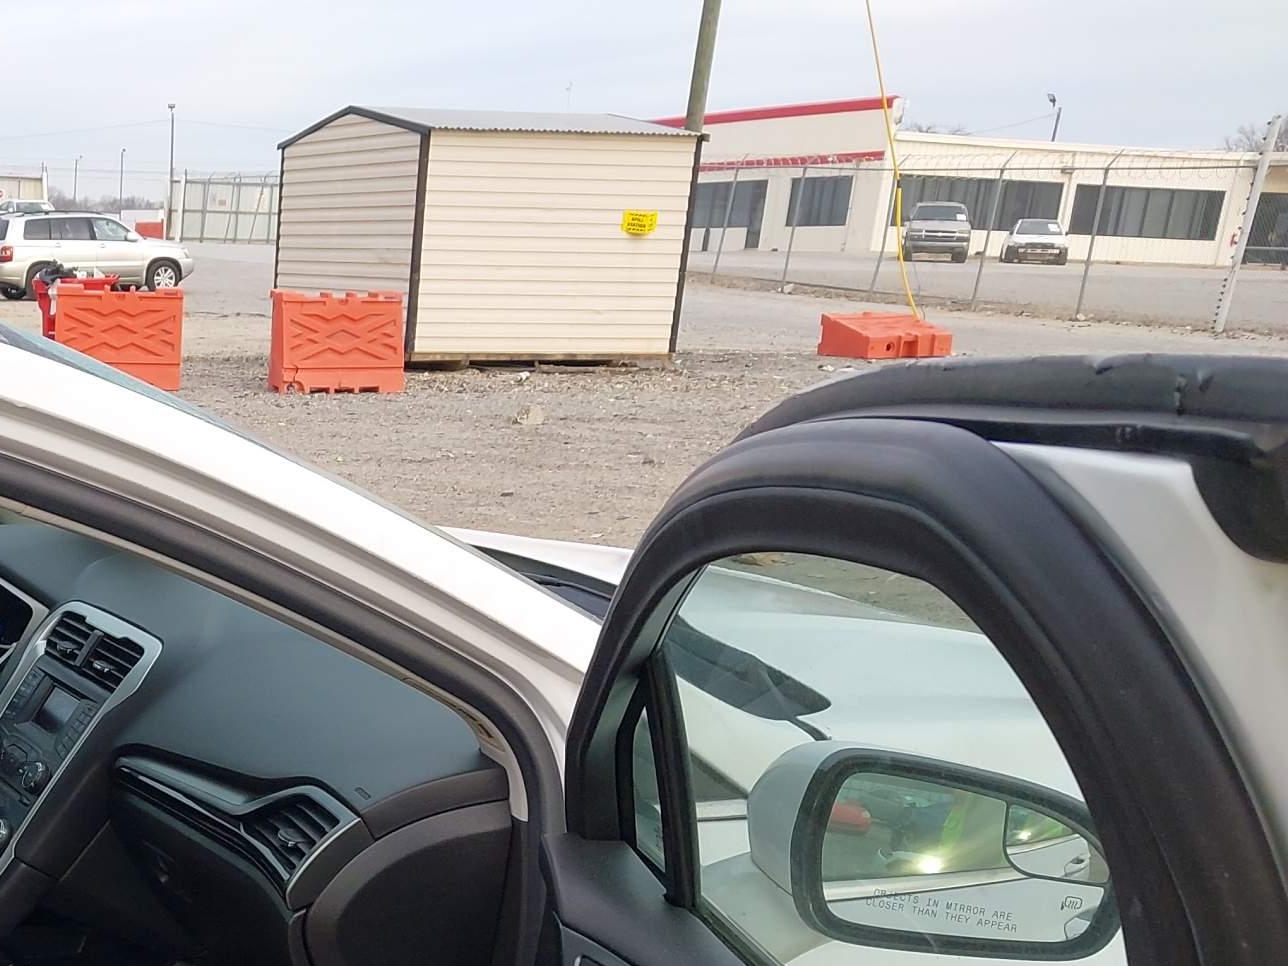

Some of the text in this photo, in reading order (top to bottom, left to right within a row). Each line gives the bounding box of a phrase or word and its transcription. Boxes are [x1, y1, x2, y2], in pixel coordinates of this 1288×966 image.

[865, 897, 1018, 933] CLOSER THAN THEY APPEAR
[873, 888, 1013, 921] OBJECTS IN MIRROR ARE
